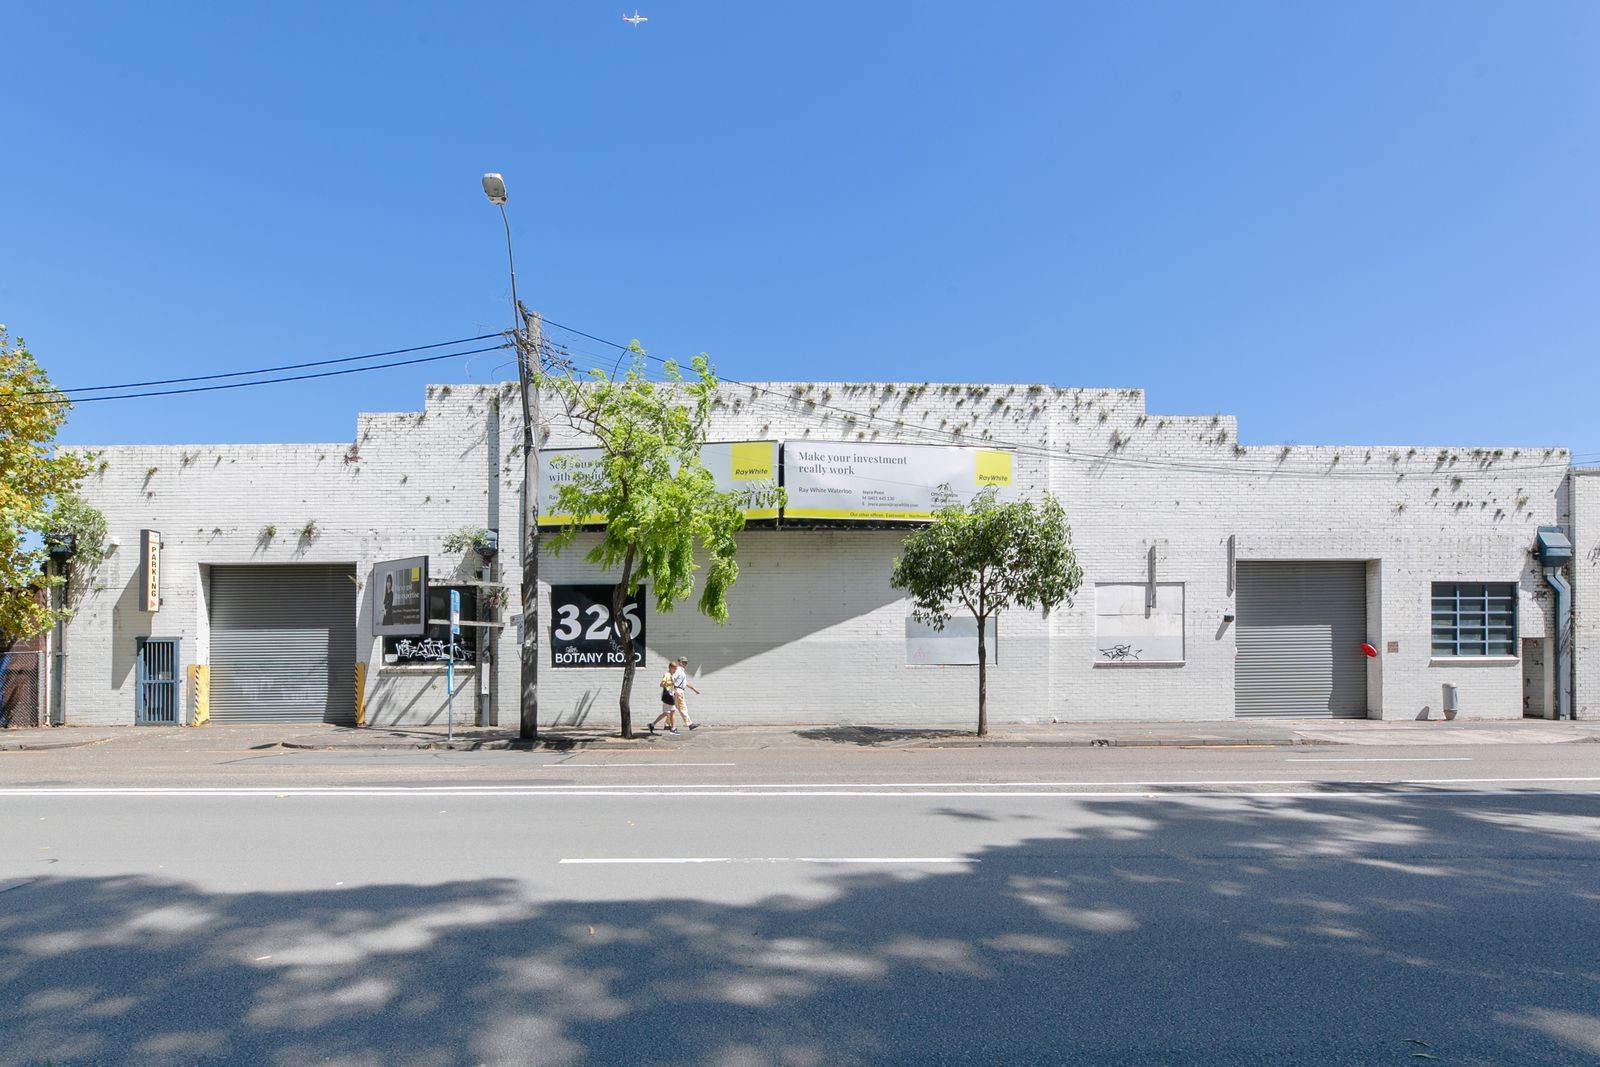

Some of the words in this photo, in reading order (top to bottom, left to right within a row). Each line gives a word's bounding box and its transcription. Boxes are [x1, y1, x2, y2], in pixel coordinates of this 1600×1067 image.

[799, 452, 826, 461] Make
[827, 454, 851, 464] your
[853, 453, 908, 465] investment
[735, 468, 769, 476] RayWhite
[799, 464, 827, 475] really
[829, 465, 855, 475] work
[549, 472, 571, 482] with
[554, 602, 643, 641] 326
[555, 652, 604, 664] BOTANY
[607, 652, 642, 664] ROD
